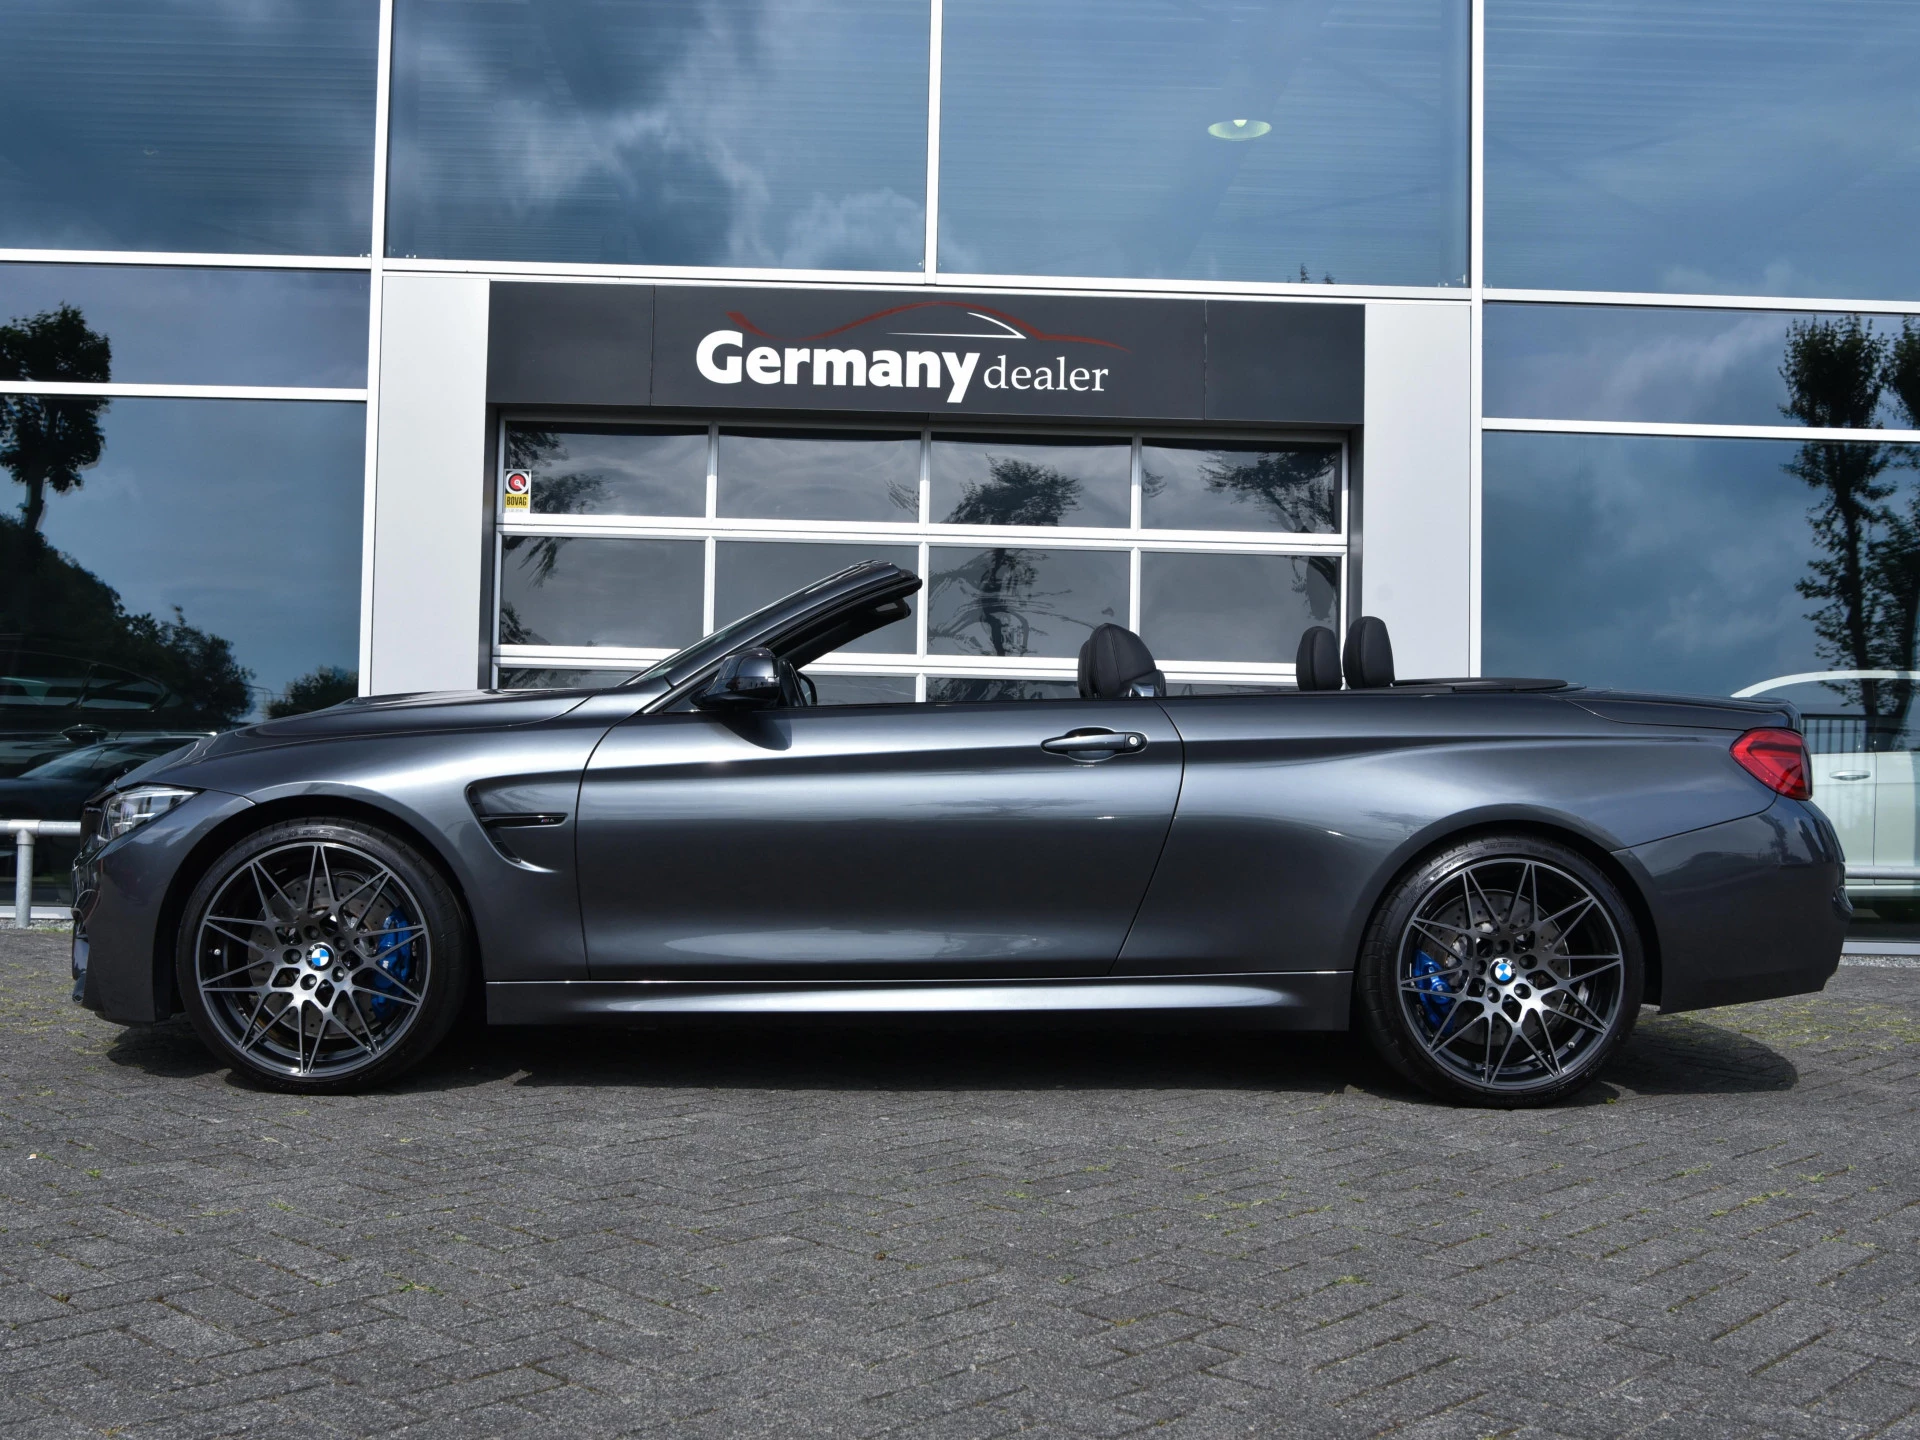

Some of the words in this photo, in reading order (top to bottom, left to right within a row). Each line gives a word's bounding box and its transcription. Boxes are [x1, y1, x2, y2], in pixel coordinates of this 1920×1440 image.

[696, 330, 980, 403] Germany
[983, 355, 1109, 393] dealer
[506, 496, 527, 506] BOVAG
